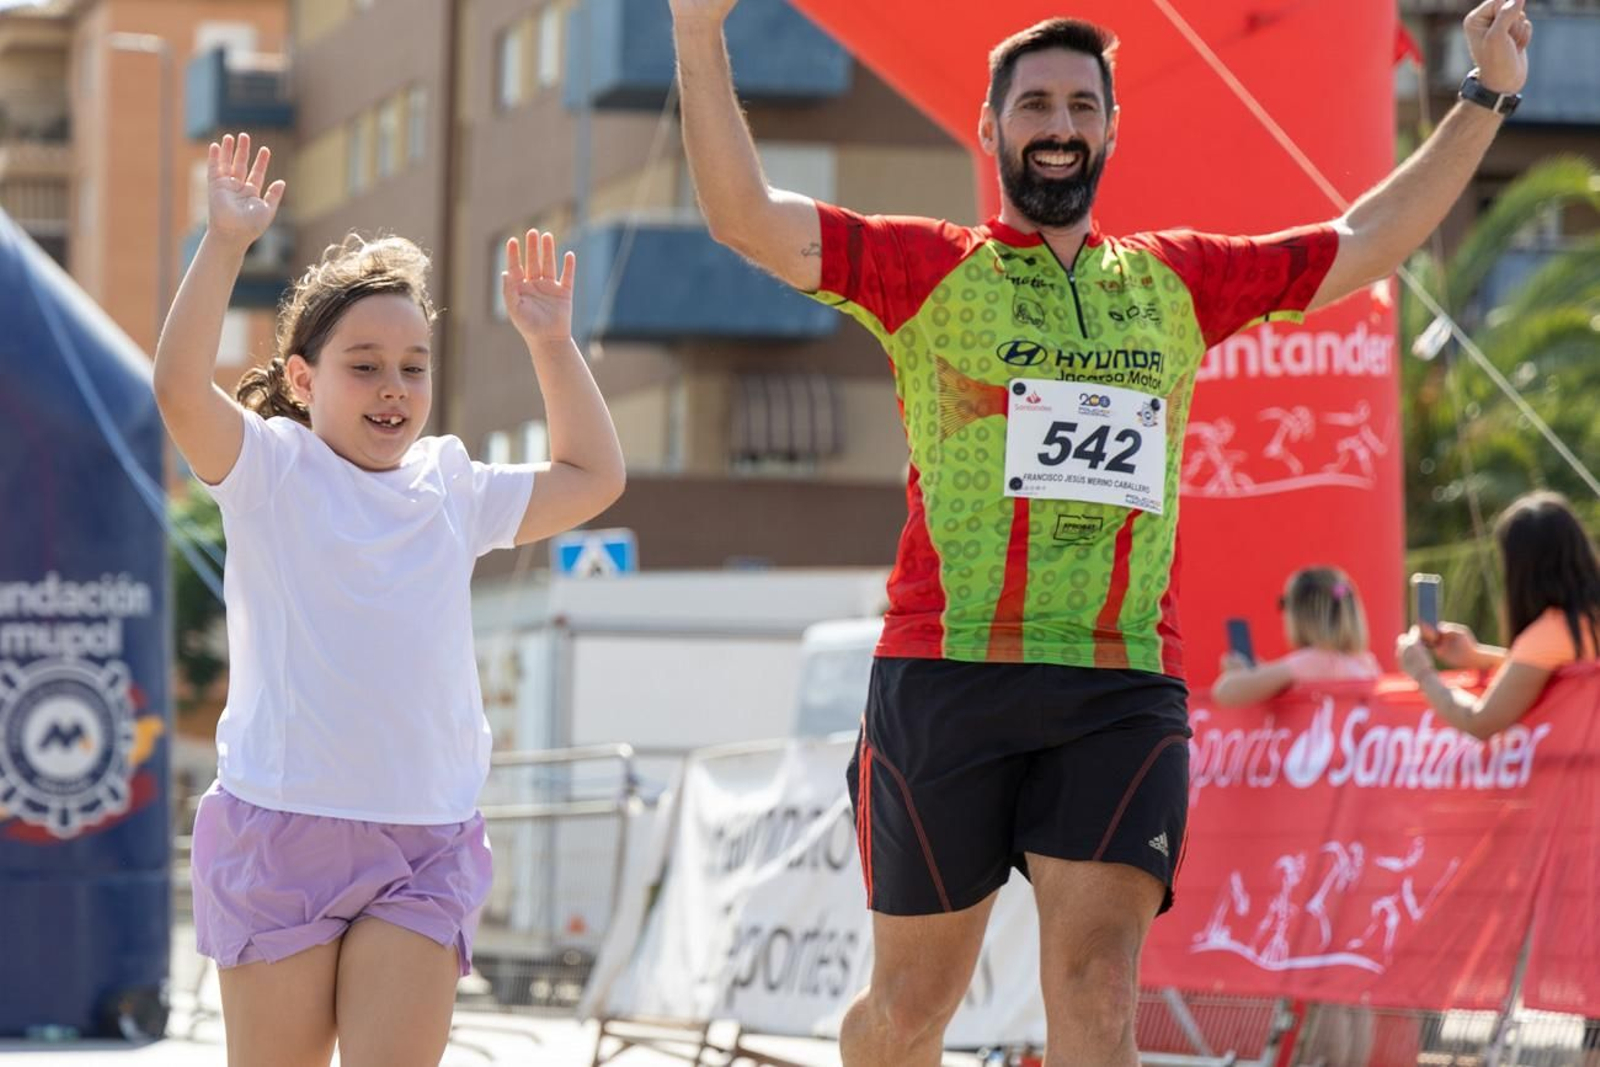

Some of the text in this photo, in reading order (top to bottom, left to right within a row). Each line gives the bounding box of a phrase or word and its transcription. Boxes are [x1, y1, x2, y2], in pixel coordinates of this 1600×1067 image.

[1055, 349, 1164, 374] HYUNDAI
[1037, 420, 1142, 475] 542
[1023, 473, 1063, 482] FRANCISCO
[1087, 477, 1113, 487] MERINO
[1114, 480, 1150, 494] CABALLERO
